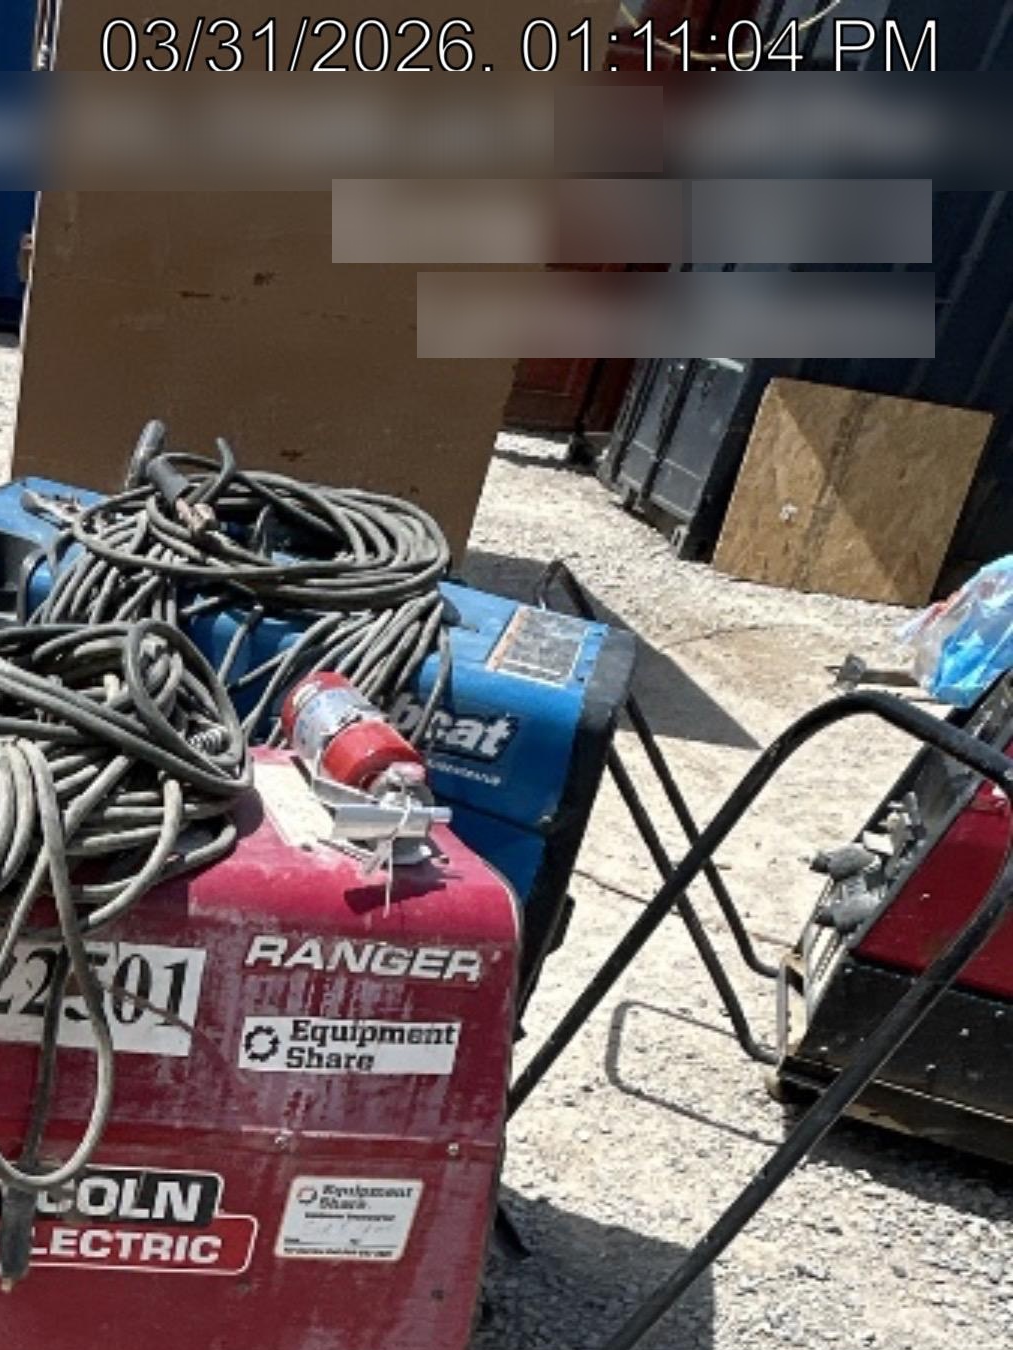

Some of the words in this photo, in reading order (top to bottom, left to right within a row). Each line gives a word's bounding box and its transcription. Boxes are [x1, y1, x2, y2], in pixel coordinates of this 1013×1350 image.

[245, 935, 481, 982] RANGER
[290, 1019, 457, 1047] Equipment
[285, 1046, 375, 1072] Share
[322, 1184, 413, 1198] Equipment
